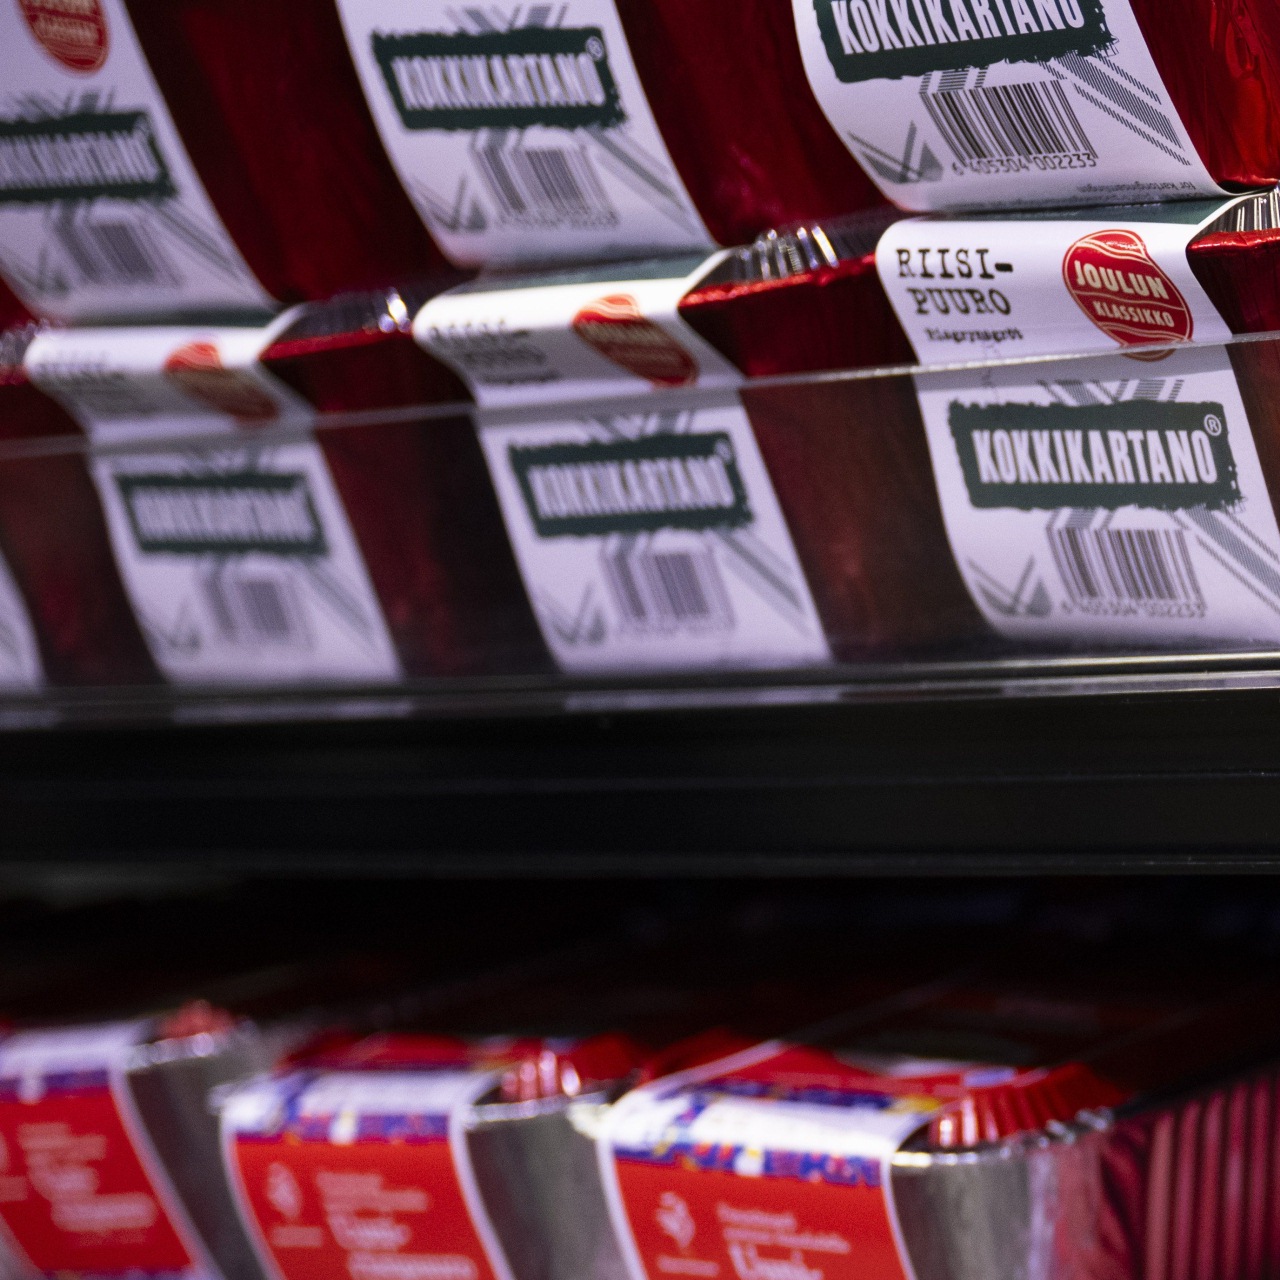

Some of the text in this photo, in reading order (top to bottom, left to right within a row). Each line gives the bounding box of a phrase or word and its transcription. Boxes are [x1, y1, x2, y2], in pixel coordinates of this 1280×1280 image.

[1032, 153, 1098, 171] 002233
[896, 248, 1013, 279] RIISI-
[1074, 260, 1169, 300] JOULUN
[907, 287, 1011, 315] PUURO
[1095, 302, 1175, 328] KLASSIKKO
[972, 429, 1217, 484] KOKKIKARTANO
